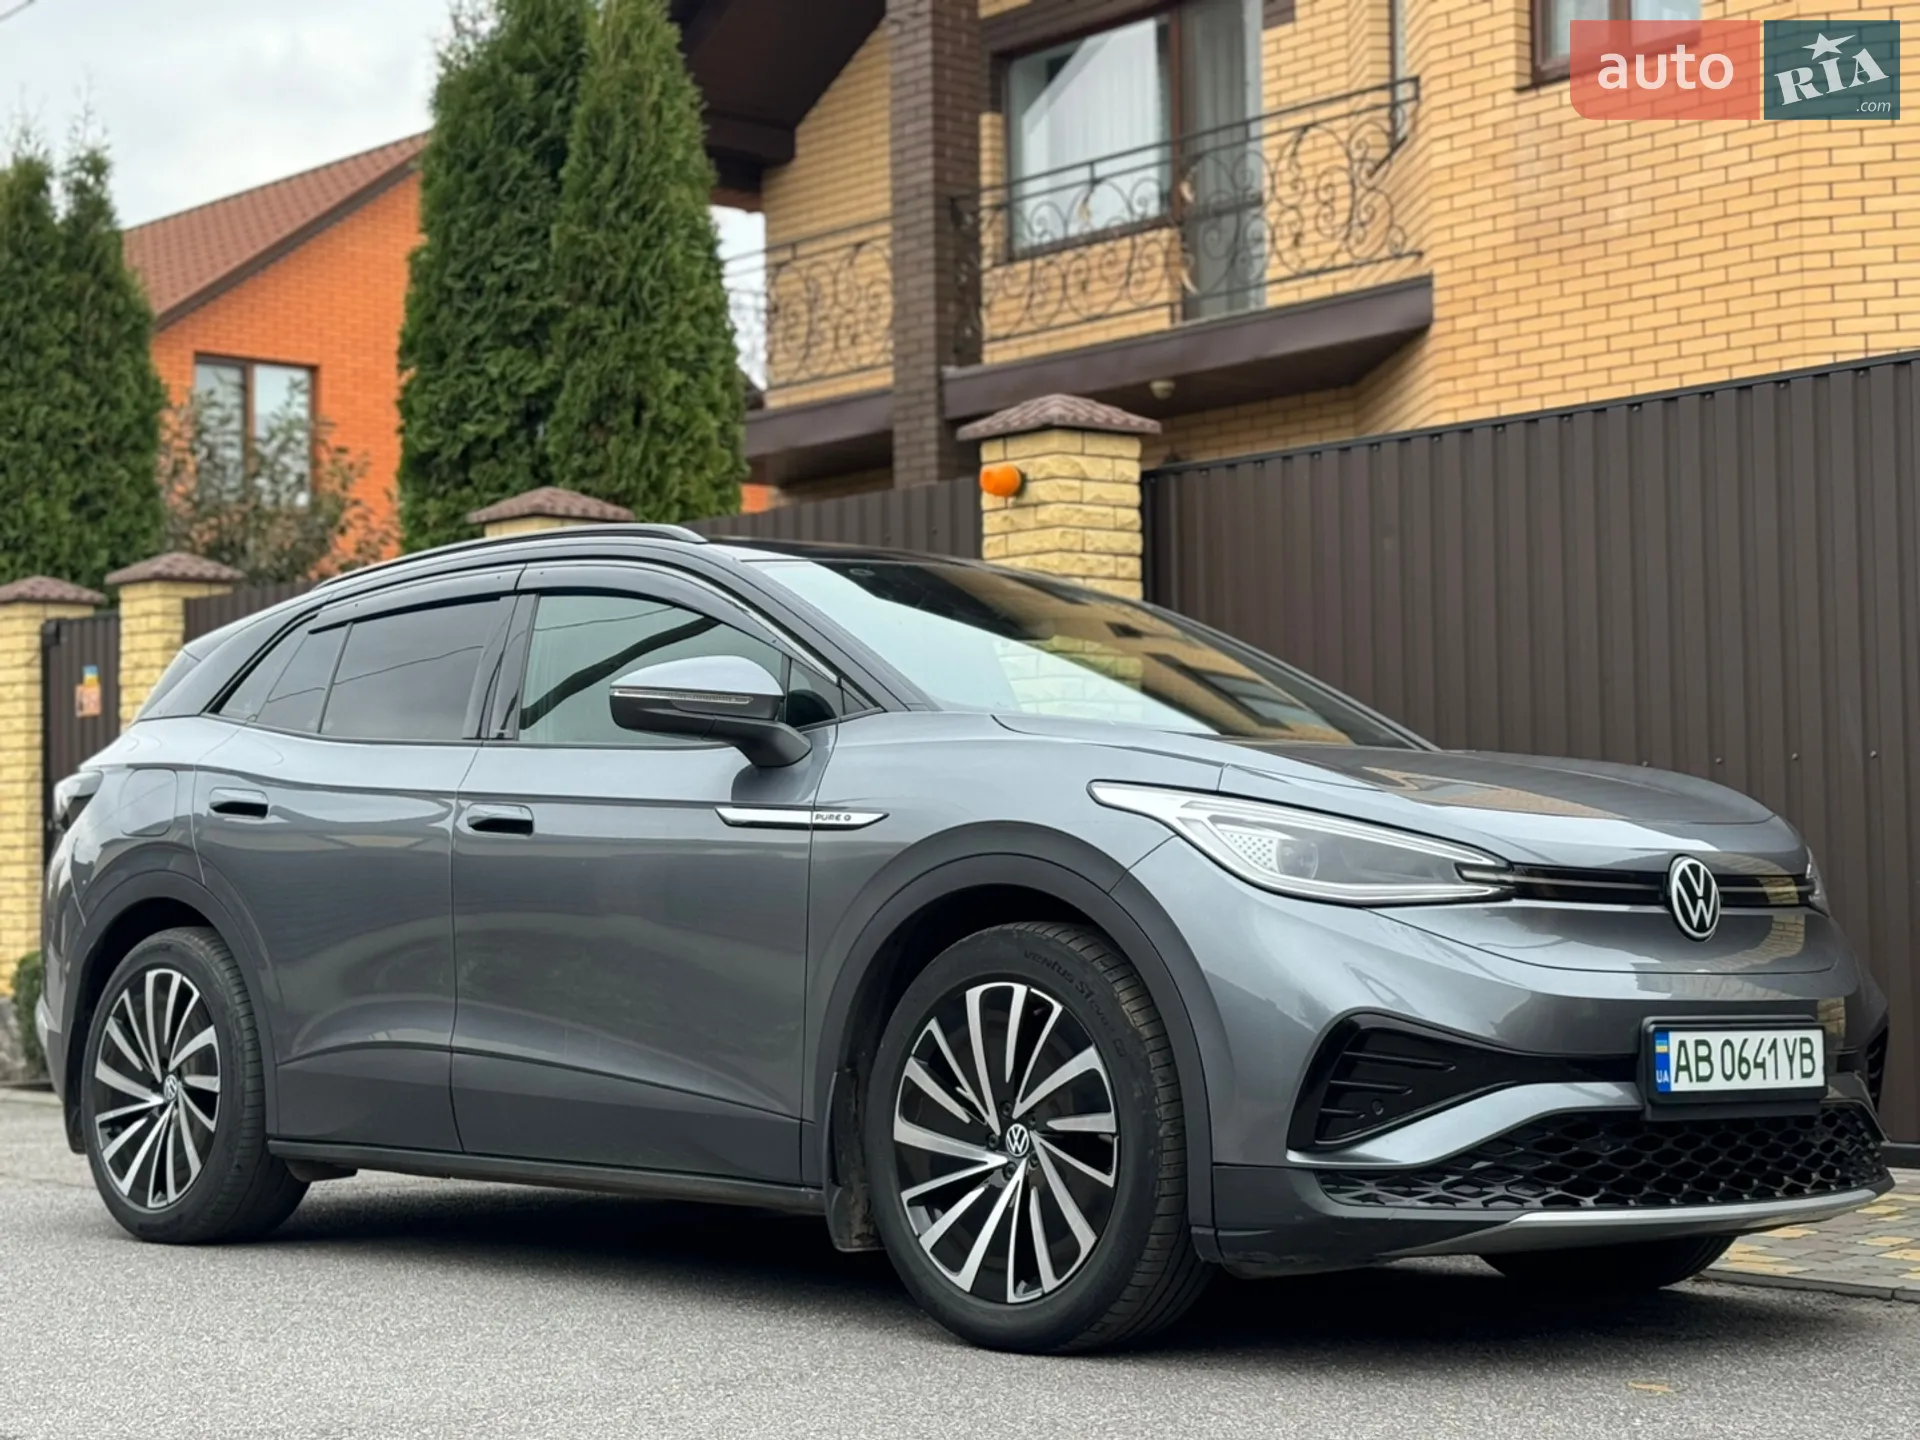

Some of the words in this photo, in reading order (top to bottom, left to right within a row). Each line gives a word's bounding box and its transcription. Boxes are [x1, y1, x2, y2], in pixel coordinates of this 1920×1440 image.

[815, 813, 842, 822] PURE
[1674, 1039, 1714, 1083] AB
[1720, 1037, 1779, 1082] 0641
[1783, 1037, 1816, 1080] YB
[1656, 1069, 1669, 1083] UA
